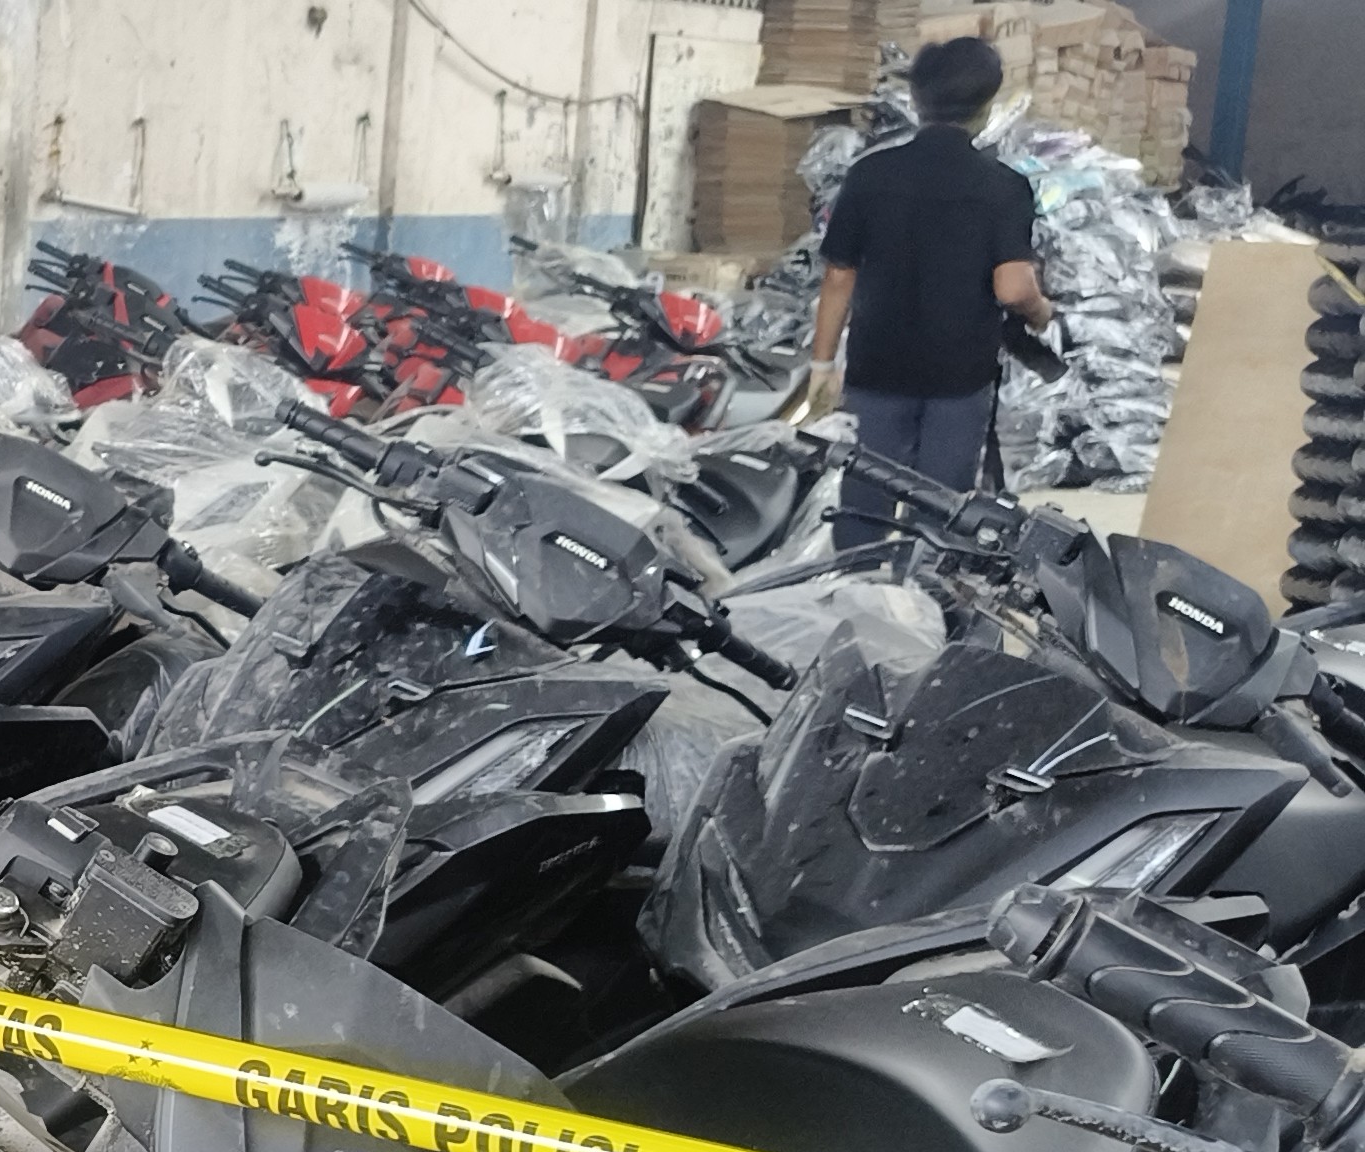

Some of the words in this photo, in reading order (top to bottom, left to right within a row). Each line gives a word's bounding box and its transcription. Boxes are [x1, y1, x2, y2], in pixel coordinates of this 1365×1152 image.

[25, 480, 71, 511] HONDA
[555, 535, 608, 570] HONDA
[1168, 596, 1224, 635] HONDA
[235, 1058, 413, 1147] GARIS
